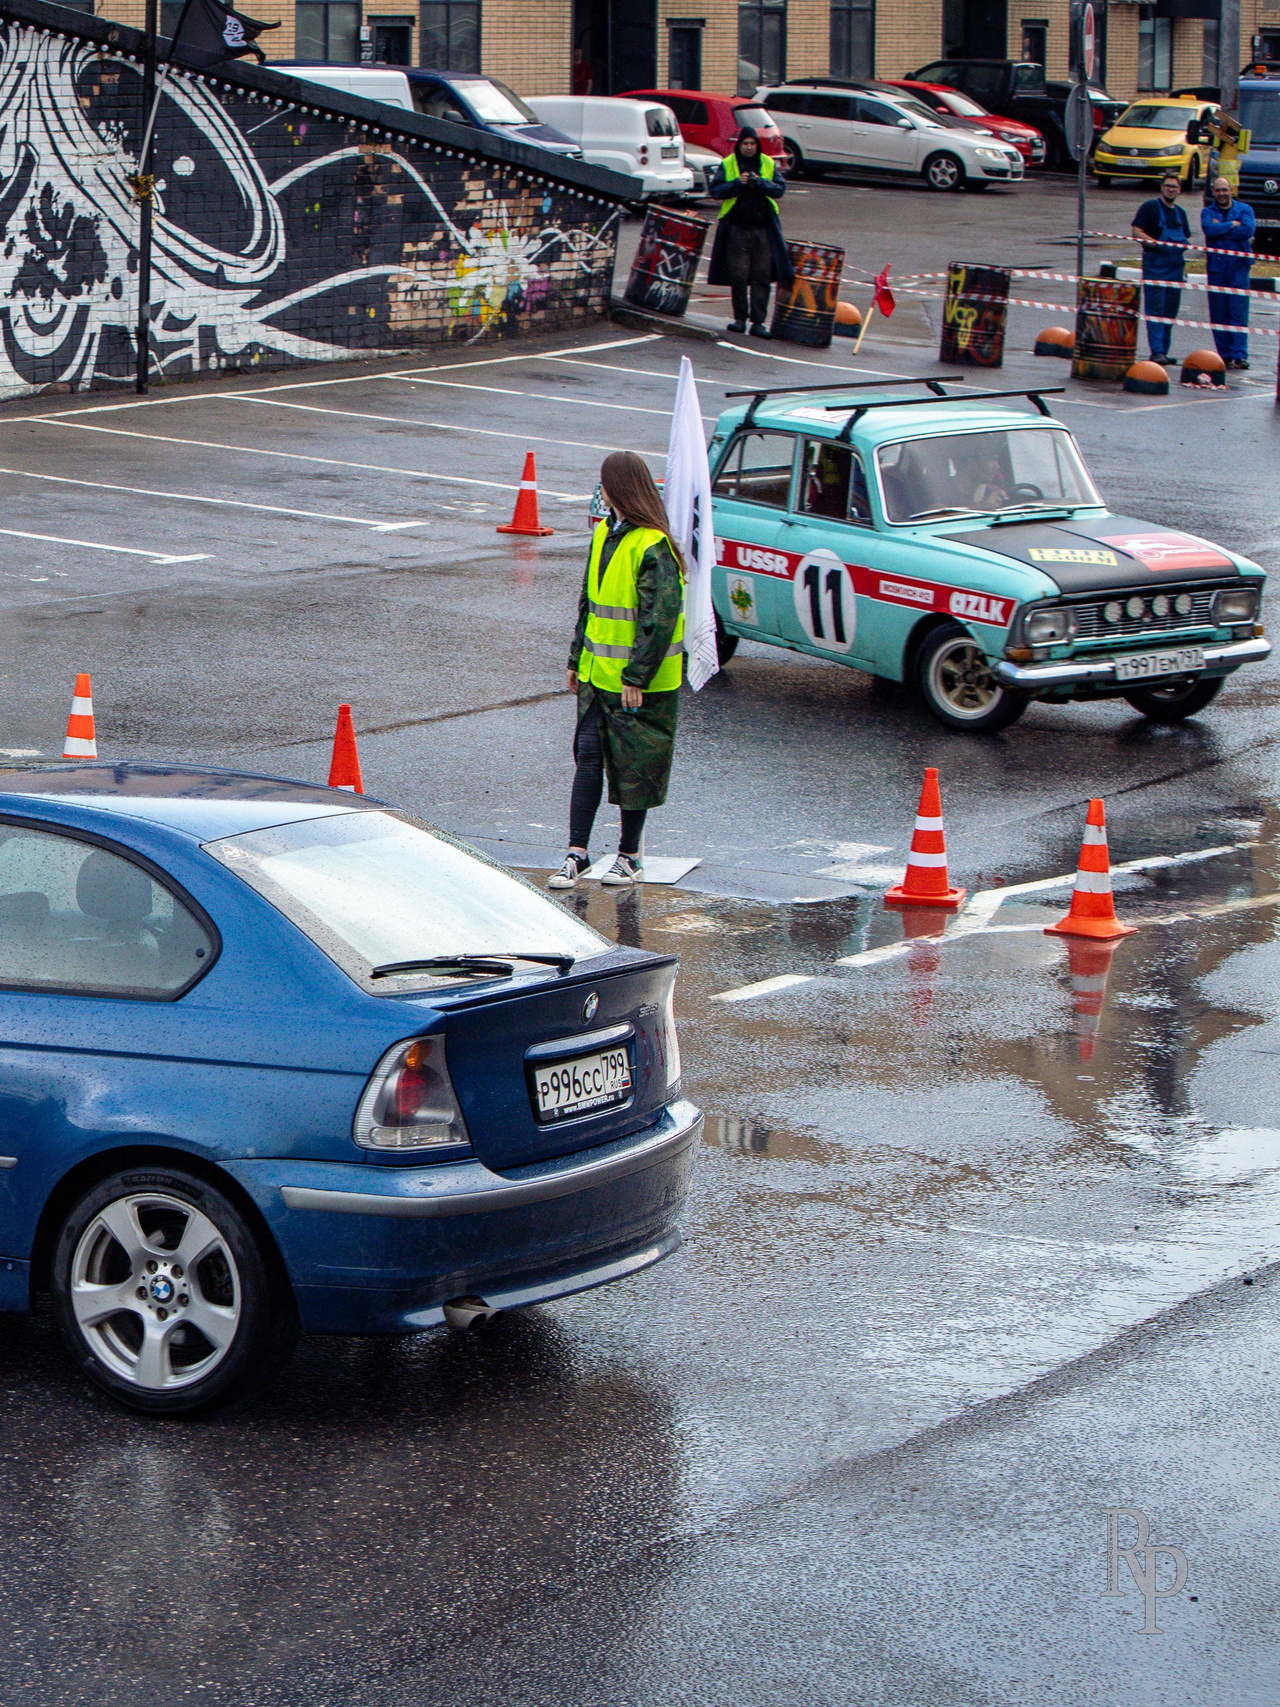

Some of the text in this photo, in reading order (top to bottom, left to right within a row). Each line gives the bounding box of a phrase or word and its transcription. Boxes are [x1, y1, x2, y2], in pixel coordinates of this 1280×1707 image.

[736, 546, 790, 576] USSR
[803, 564, 847, 644] 11
[601, 1052, 625, 1081] 799
[610, 1079, 622, 1090] RUS
